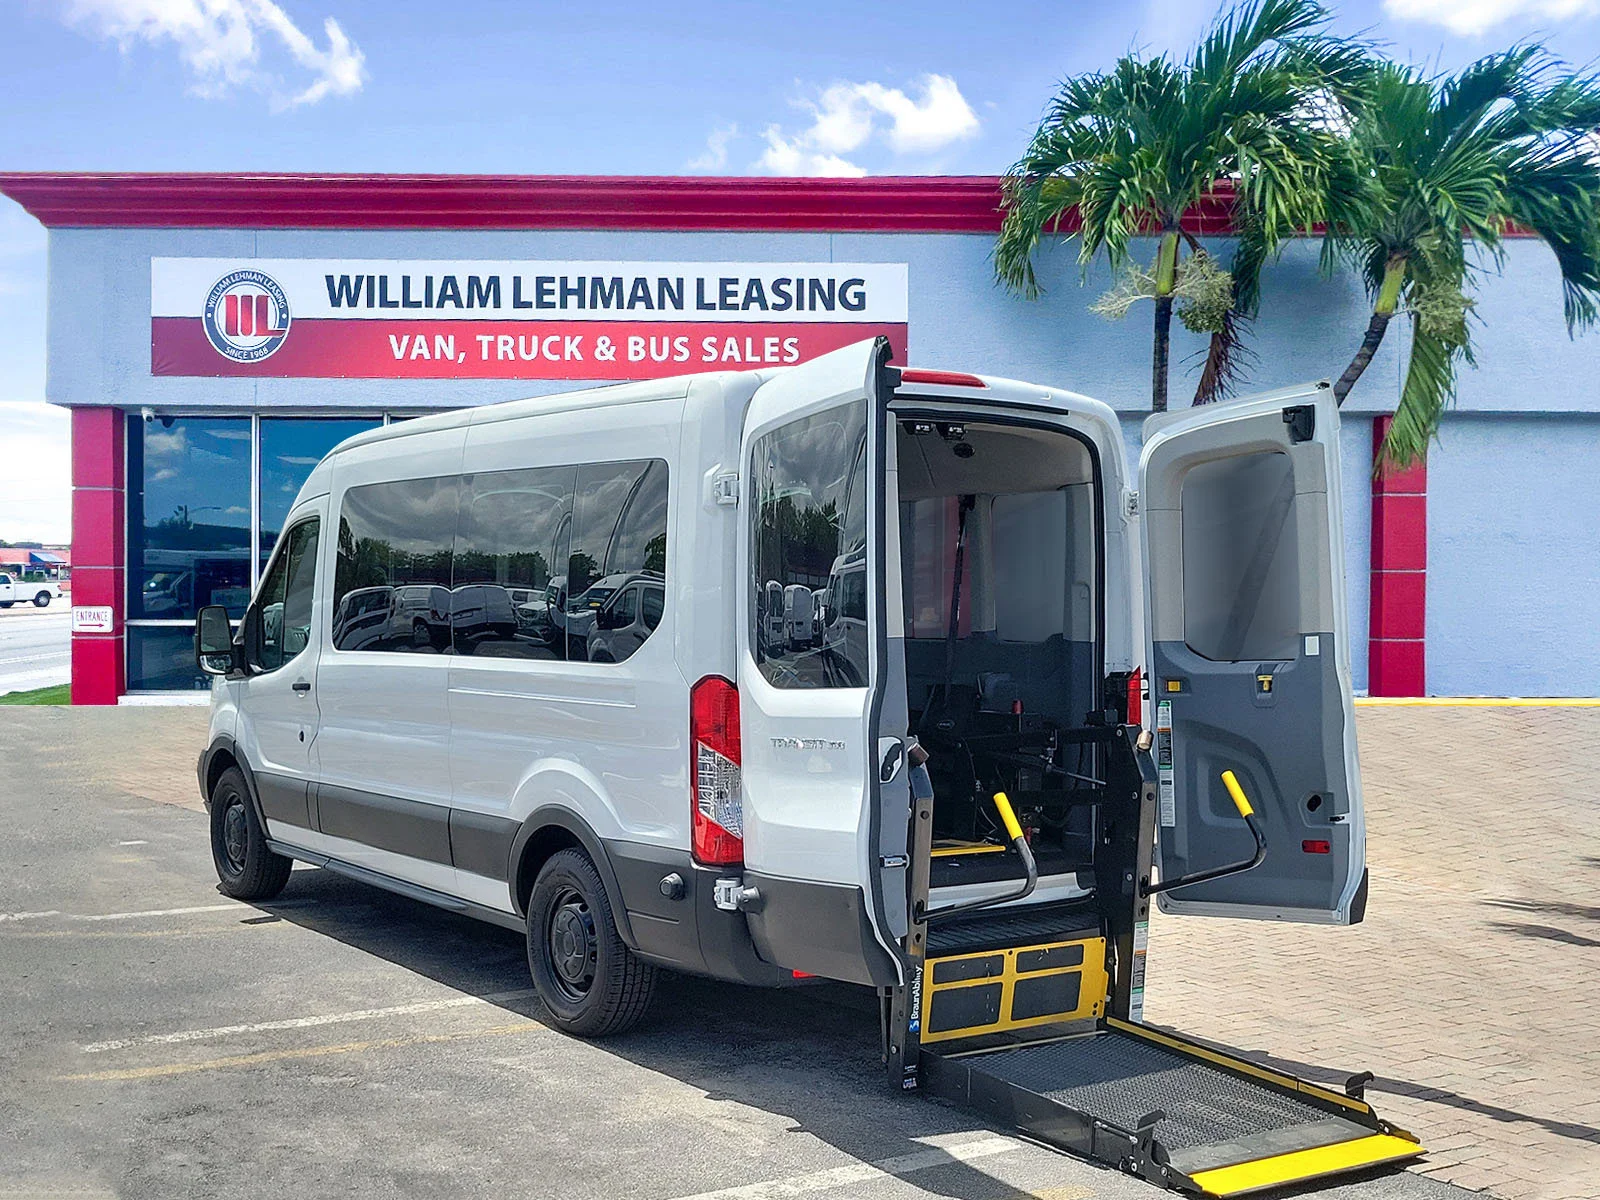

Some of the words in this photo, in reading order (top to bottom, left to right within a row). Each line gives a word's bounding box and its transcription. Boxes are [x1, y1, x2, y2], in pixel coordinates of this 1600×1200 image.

[208, 278, 231, 308] WILLIAM
[231, 272, 264, 283] LEHMAN
[264, 278, 286, 309] LEASING
[325, 274, 501, 309] WILLIAM
[512, 276, 684, 310] LEHMAN
[696, 277, 866, 311] LEASING
[224, 346, 248, 359] SINCE
[250, 346, 269, 359] 1968
[389, 334, 466, 363] VAN,
[476, 335, 584, 362] TRUCK
[594, 335, 616, 362] &
[627, 336, 691, 362] BUS
[702, 336, 800, 364] SALES
[76, 611, 108, 621] ENTRANCE
